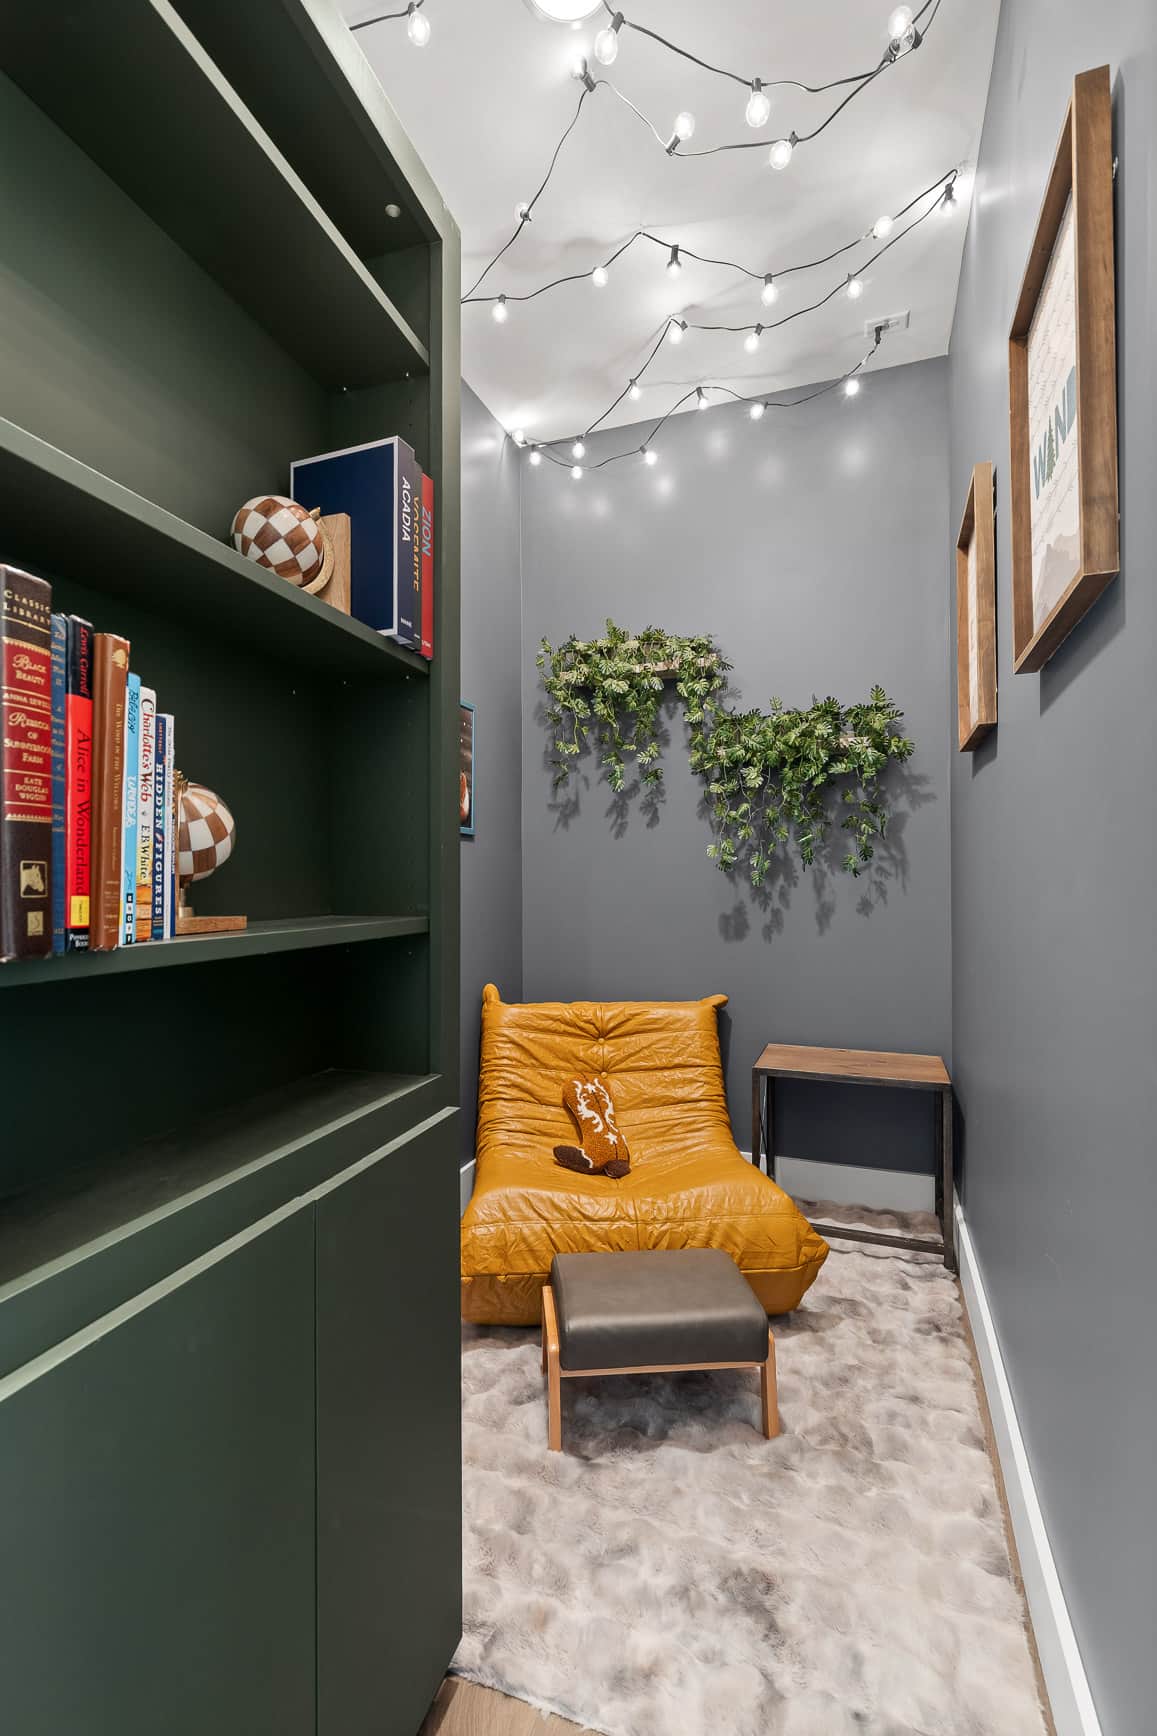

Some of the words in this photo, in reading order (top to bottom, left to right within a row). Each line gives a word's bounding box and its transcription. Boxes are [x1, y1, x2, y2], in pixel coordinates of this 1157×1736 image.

[402, 476, 411, 542] ACADIA
[422, 506, 432, 557] ZION
[80, 627, 89, 656] Lewis
[16, 670, 46, 686] BEAUTY
[80, 657, 90, 698] Carroll
[76, 728, 91, 773] Alice
[141, 698, 155, 769] Charlotte's
[76, 778, 89, 793] in
[140, 772, 153, 802] Web
[155, 764, 164, 829] HIDDEN
[75, 799, 91, 897] Wonderland
[140, 845, 151, 879] White
[154, 842, 164, 915] FIGURES
